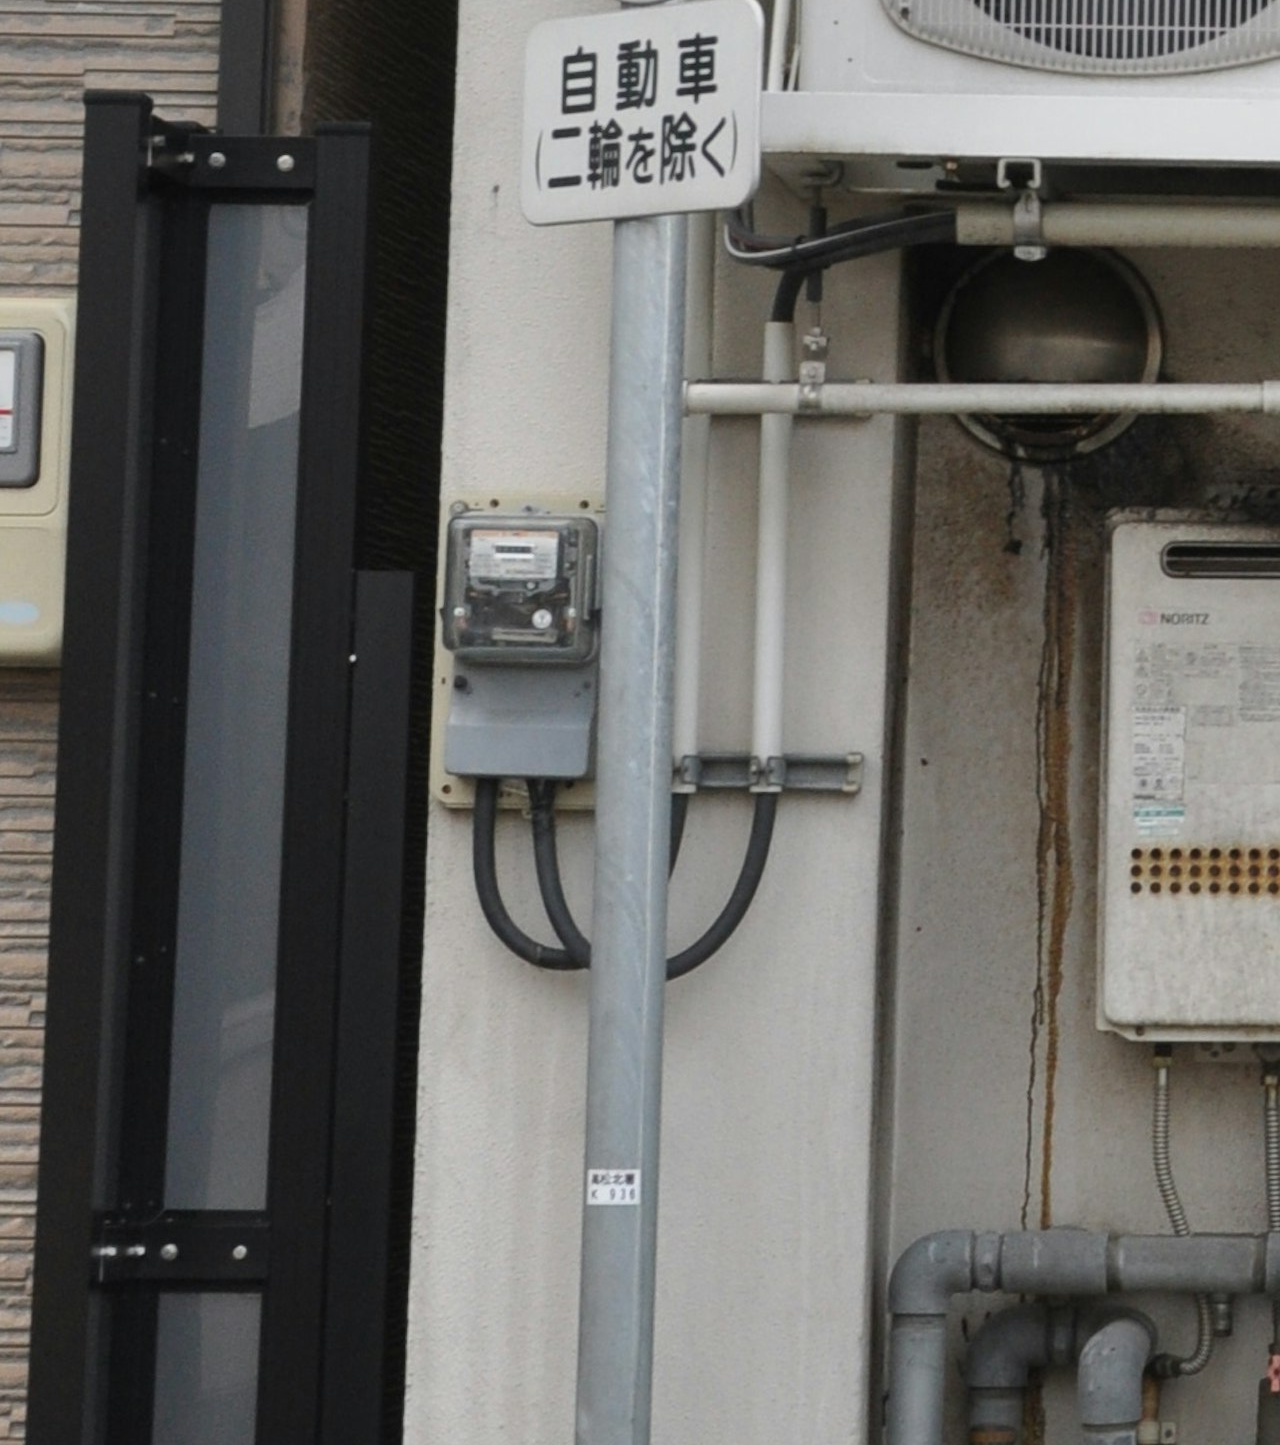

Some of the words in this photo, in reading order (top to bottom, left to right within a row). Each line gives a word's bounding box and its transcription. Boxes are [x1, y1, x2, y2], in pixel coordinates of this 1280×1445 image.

[561, 33, 719, 114] 自動車
[535, 109, 737, 191] (二輪を除く)
[1160, 612, 1211, 626] NORITZ
